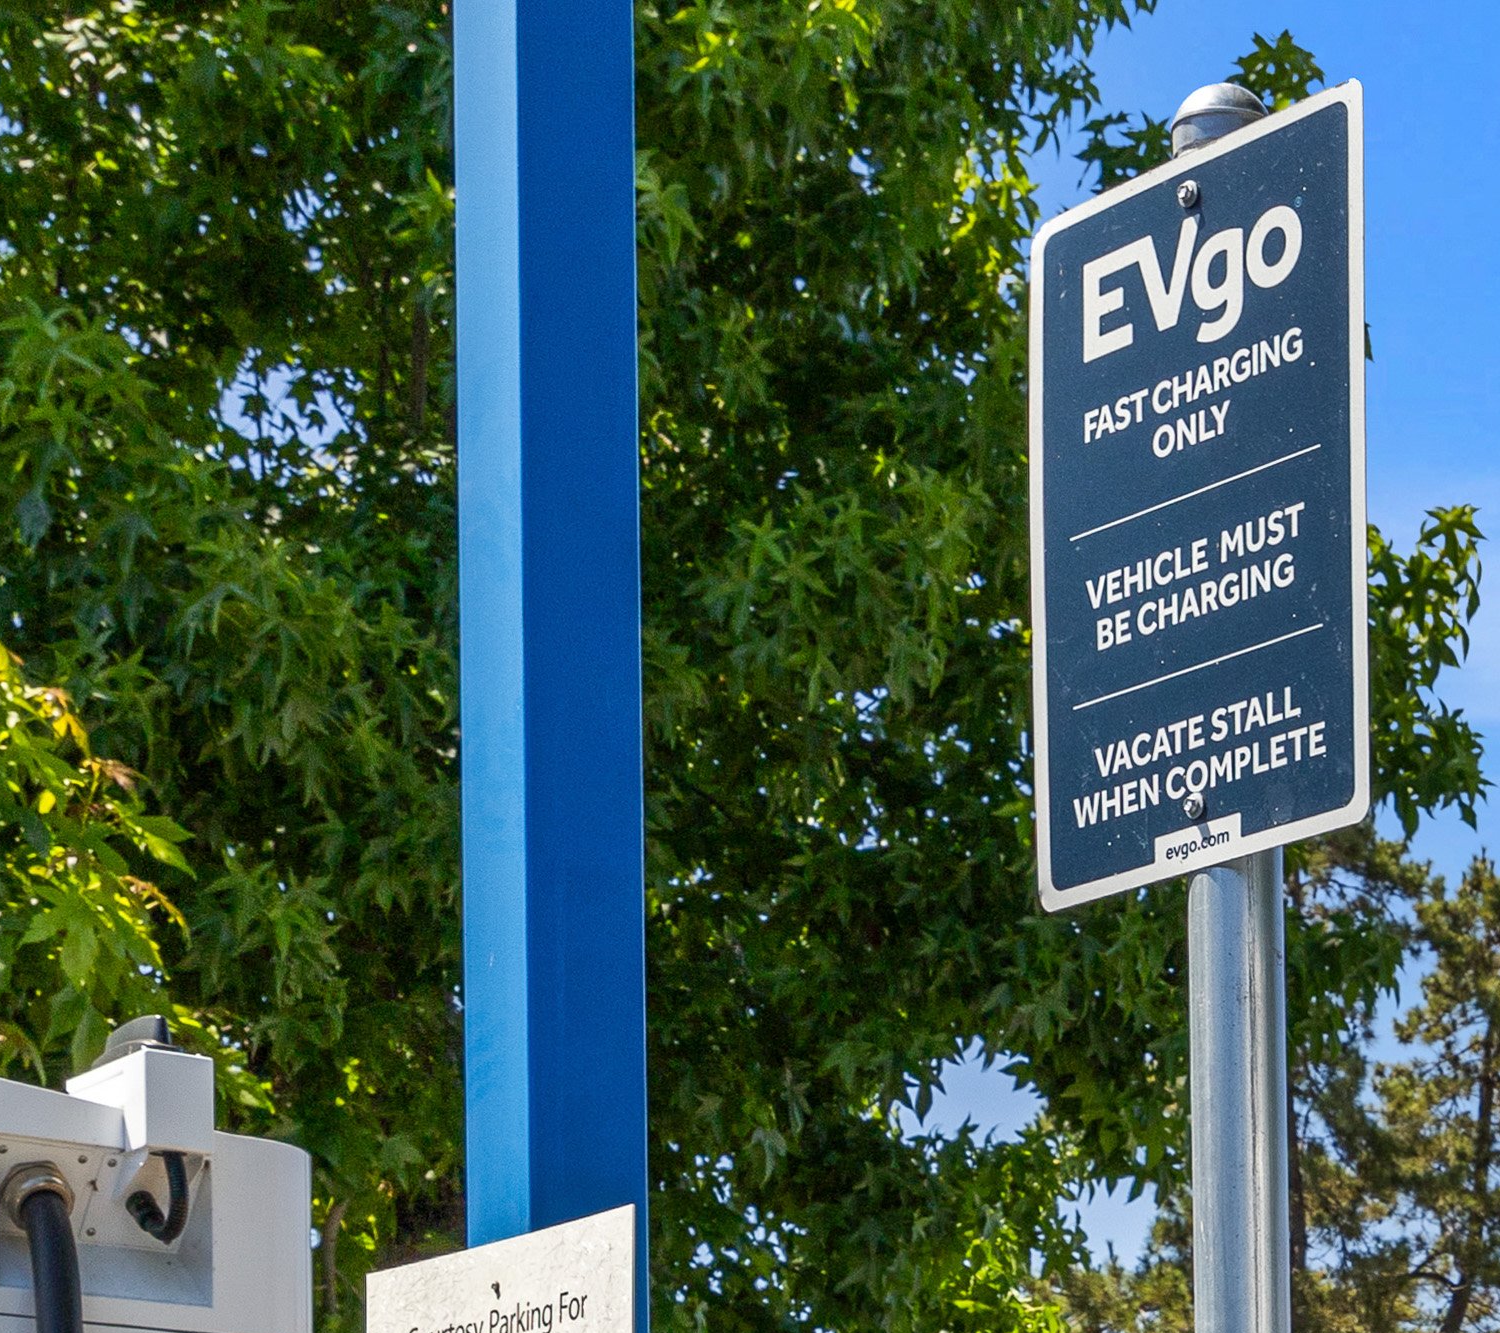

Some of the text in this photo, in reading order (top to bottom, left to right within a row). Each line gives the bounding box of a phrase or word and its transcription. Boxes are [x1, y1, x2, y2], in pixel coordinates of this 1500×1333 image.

[1083, 205, 1302, 364] EVgo
[1084, 327, 1303, 443] FAST CHARGING
[1152, 400, 1230, 458] ONLY
[1085, 502, 1305, 610] VEHICLE MUST
[1097, 553, 1294, 651] BE CHARGING
[1073, 722, 1326, 828] WHEN COMPLETE
[1095, 686, 1301, 778] VACATE STALL
[1165, 830, 1229, 860] evgo.com
[559, 1291, 587, 1323] For
